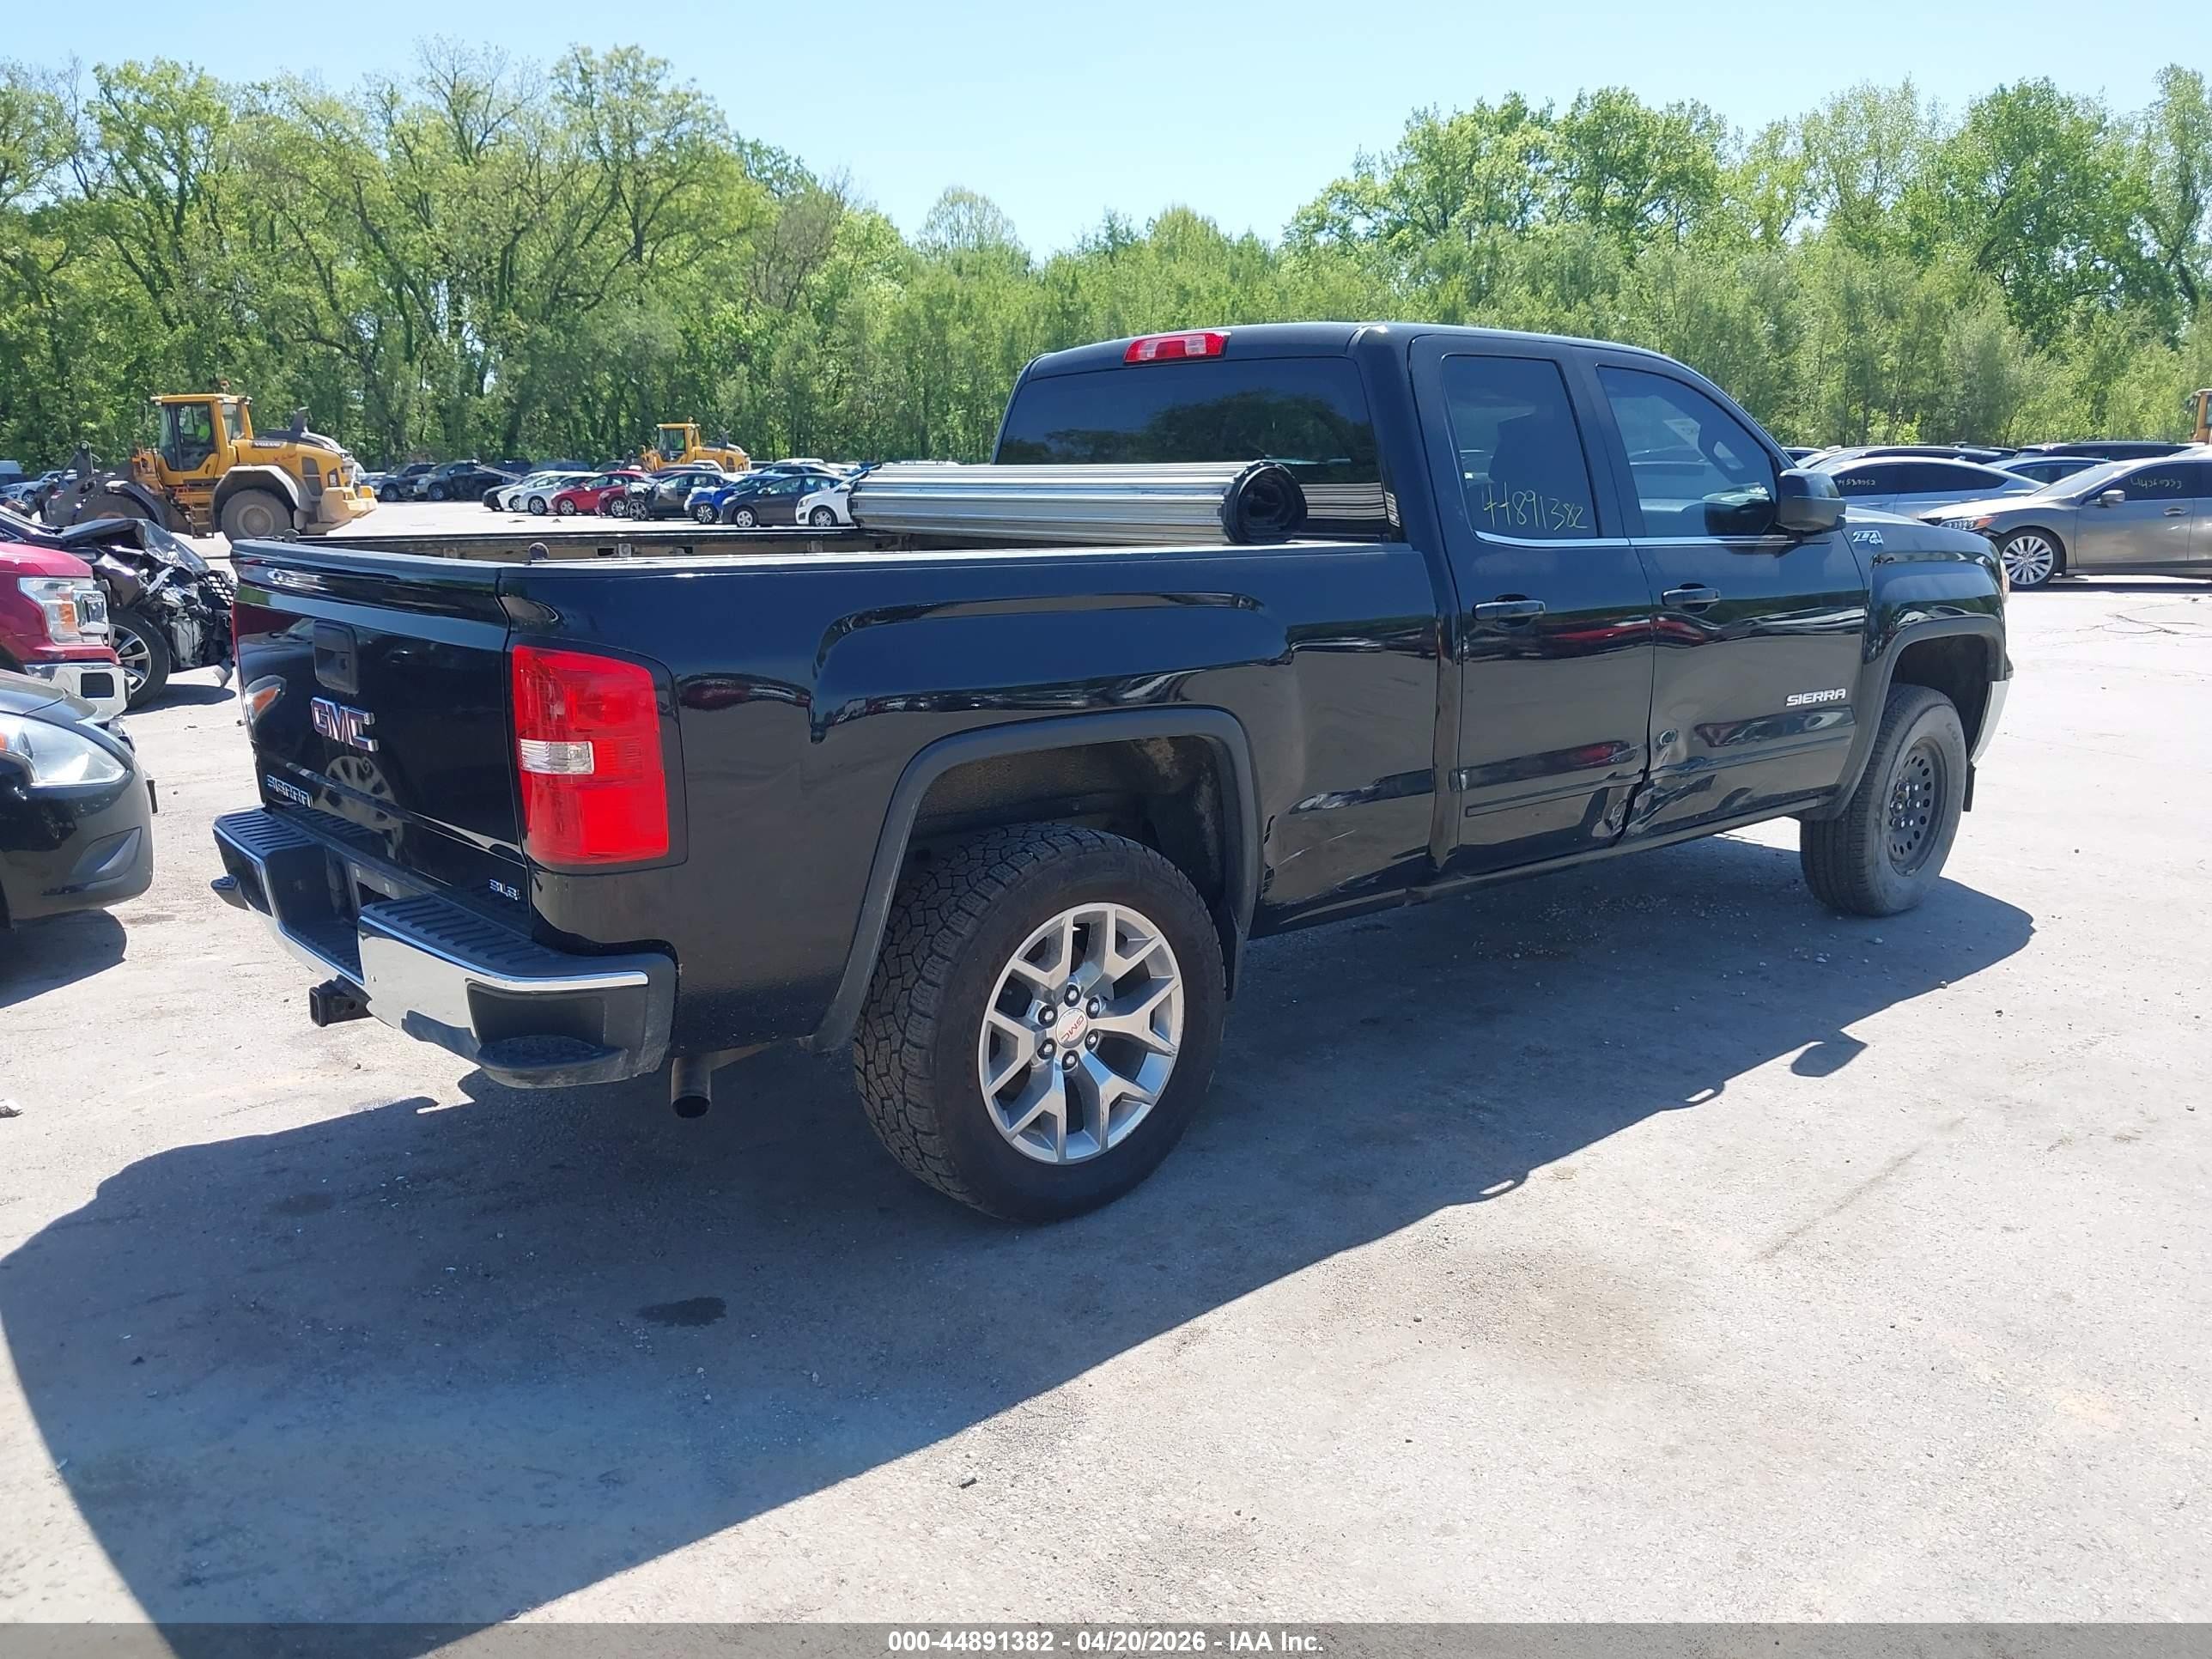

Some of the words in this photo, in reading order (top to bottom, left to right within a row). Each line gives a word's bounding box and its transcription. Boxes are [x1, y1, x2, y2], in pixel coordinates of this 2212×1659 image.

[1482, 482, 1587, 531] 44891382
[1786, 688, 1846, 707] SIERRA
[311, 697, 379, 752] GMC
[267, 775, 313, 808] SIERRA
[1060, 1015, 1085, 1041] GMC
